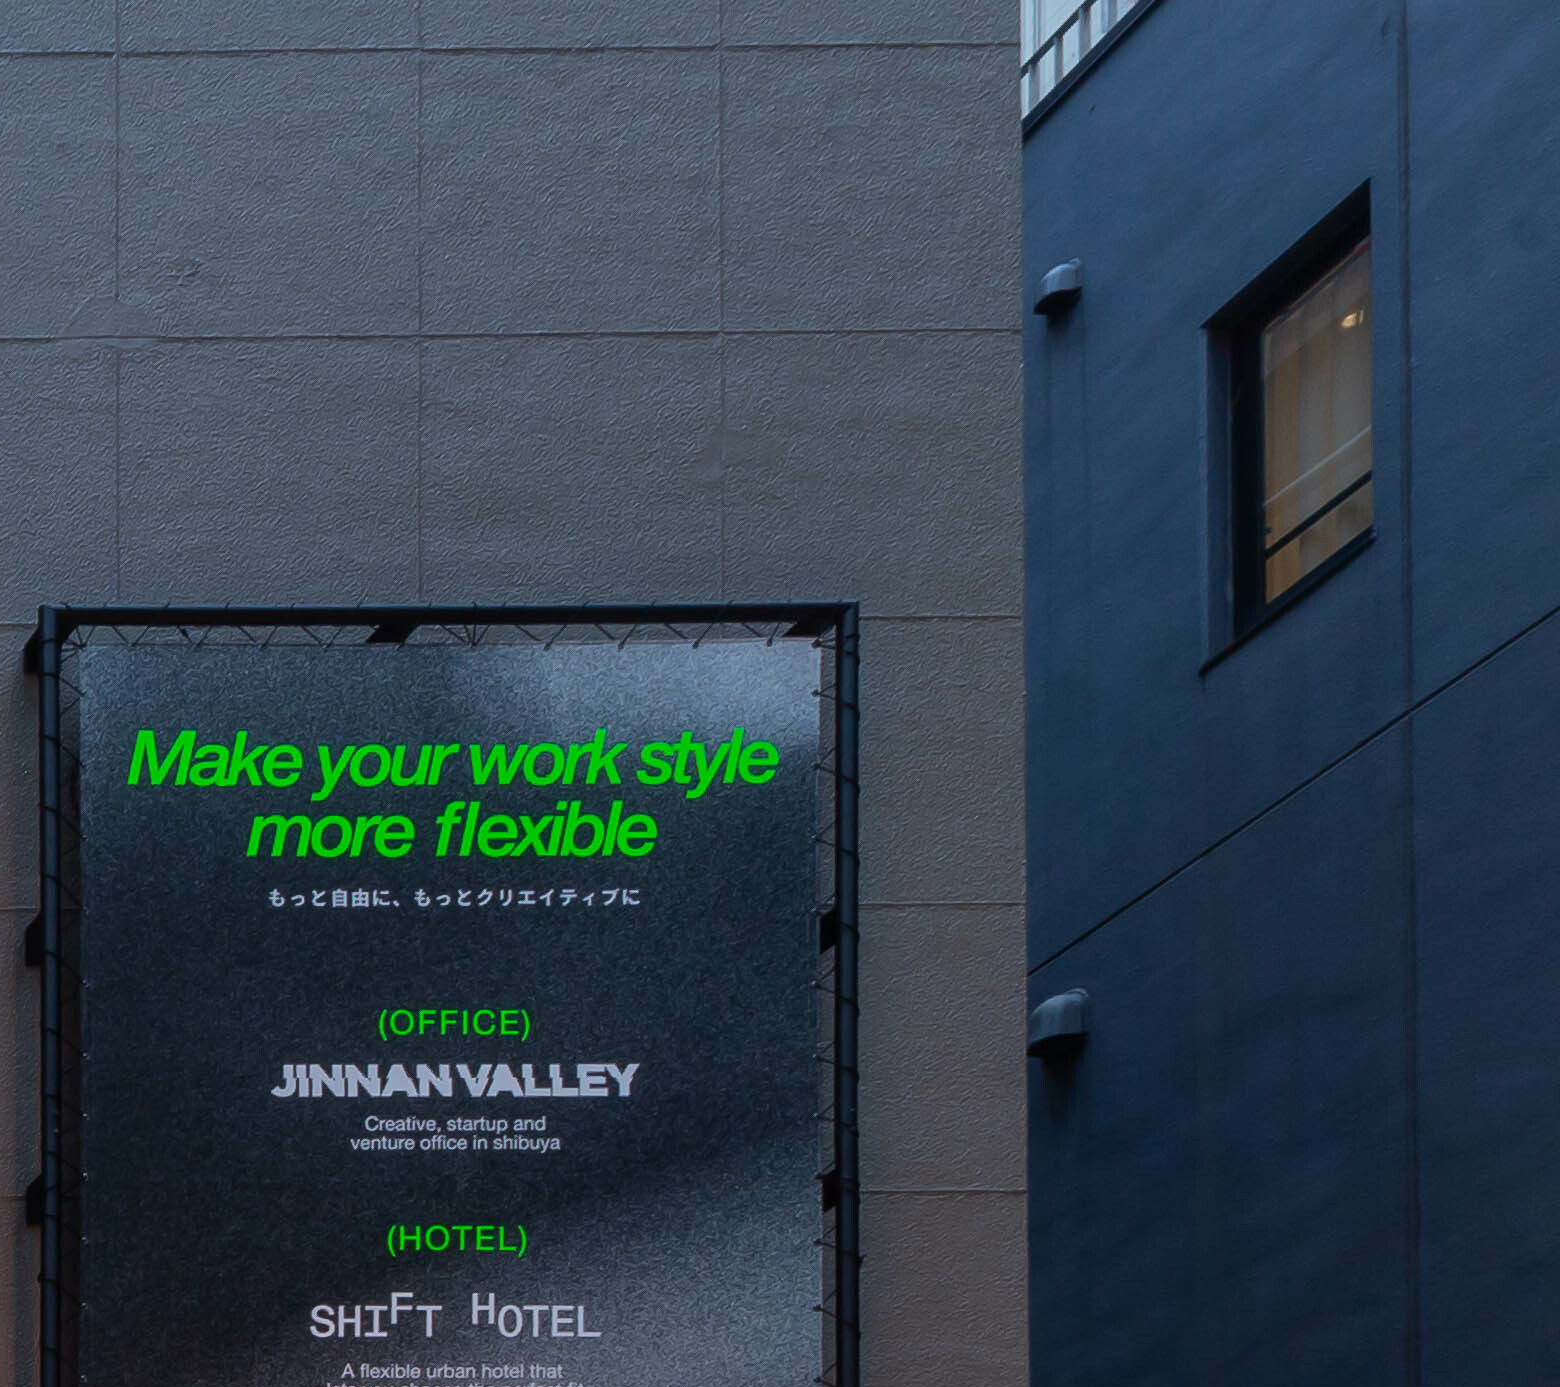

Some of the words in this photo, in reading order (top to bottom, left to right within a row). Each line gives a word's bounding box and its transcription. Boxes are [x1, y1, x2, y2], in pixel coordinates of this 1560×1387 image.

[127, 729, 303, 788] Make
[311, 744, 460, 802] your
[469, 729, 628, 788] work
[636, 728, 780, 801] style
[246, 813, 416, 858] more
[436, 801, 658, 858] flexible
[268, 887, 641, 908] もっと自由に、もっとクリエイティブに
[378, 1009, 531, 1041] (OFFICE)
[364, 1115, 442, 1134] Creative,
[446, 1116, 508, 1134] startup
[512, 1115, 547, 1132] and
[350, 1136, 415, 1150] venture
[420, 1134, 468, 1151] office
[472, 1134, 488, 1150] in
[492, 1134, 561, 1154] shibuya
[386, 1225, 528, 1257] (HOTEL)
[340, 1363, 355, 1379] A
[360, 1363, 421, 1379] flexible
[426, 1363, 476, 1379] urban
[481, 1363, 525, 1379] hotel
[529, 1363, 563, 1379] that
